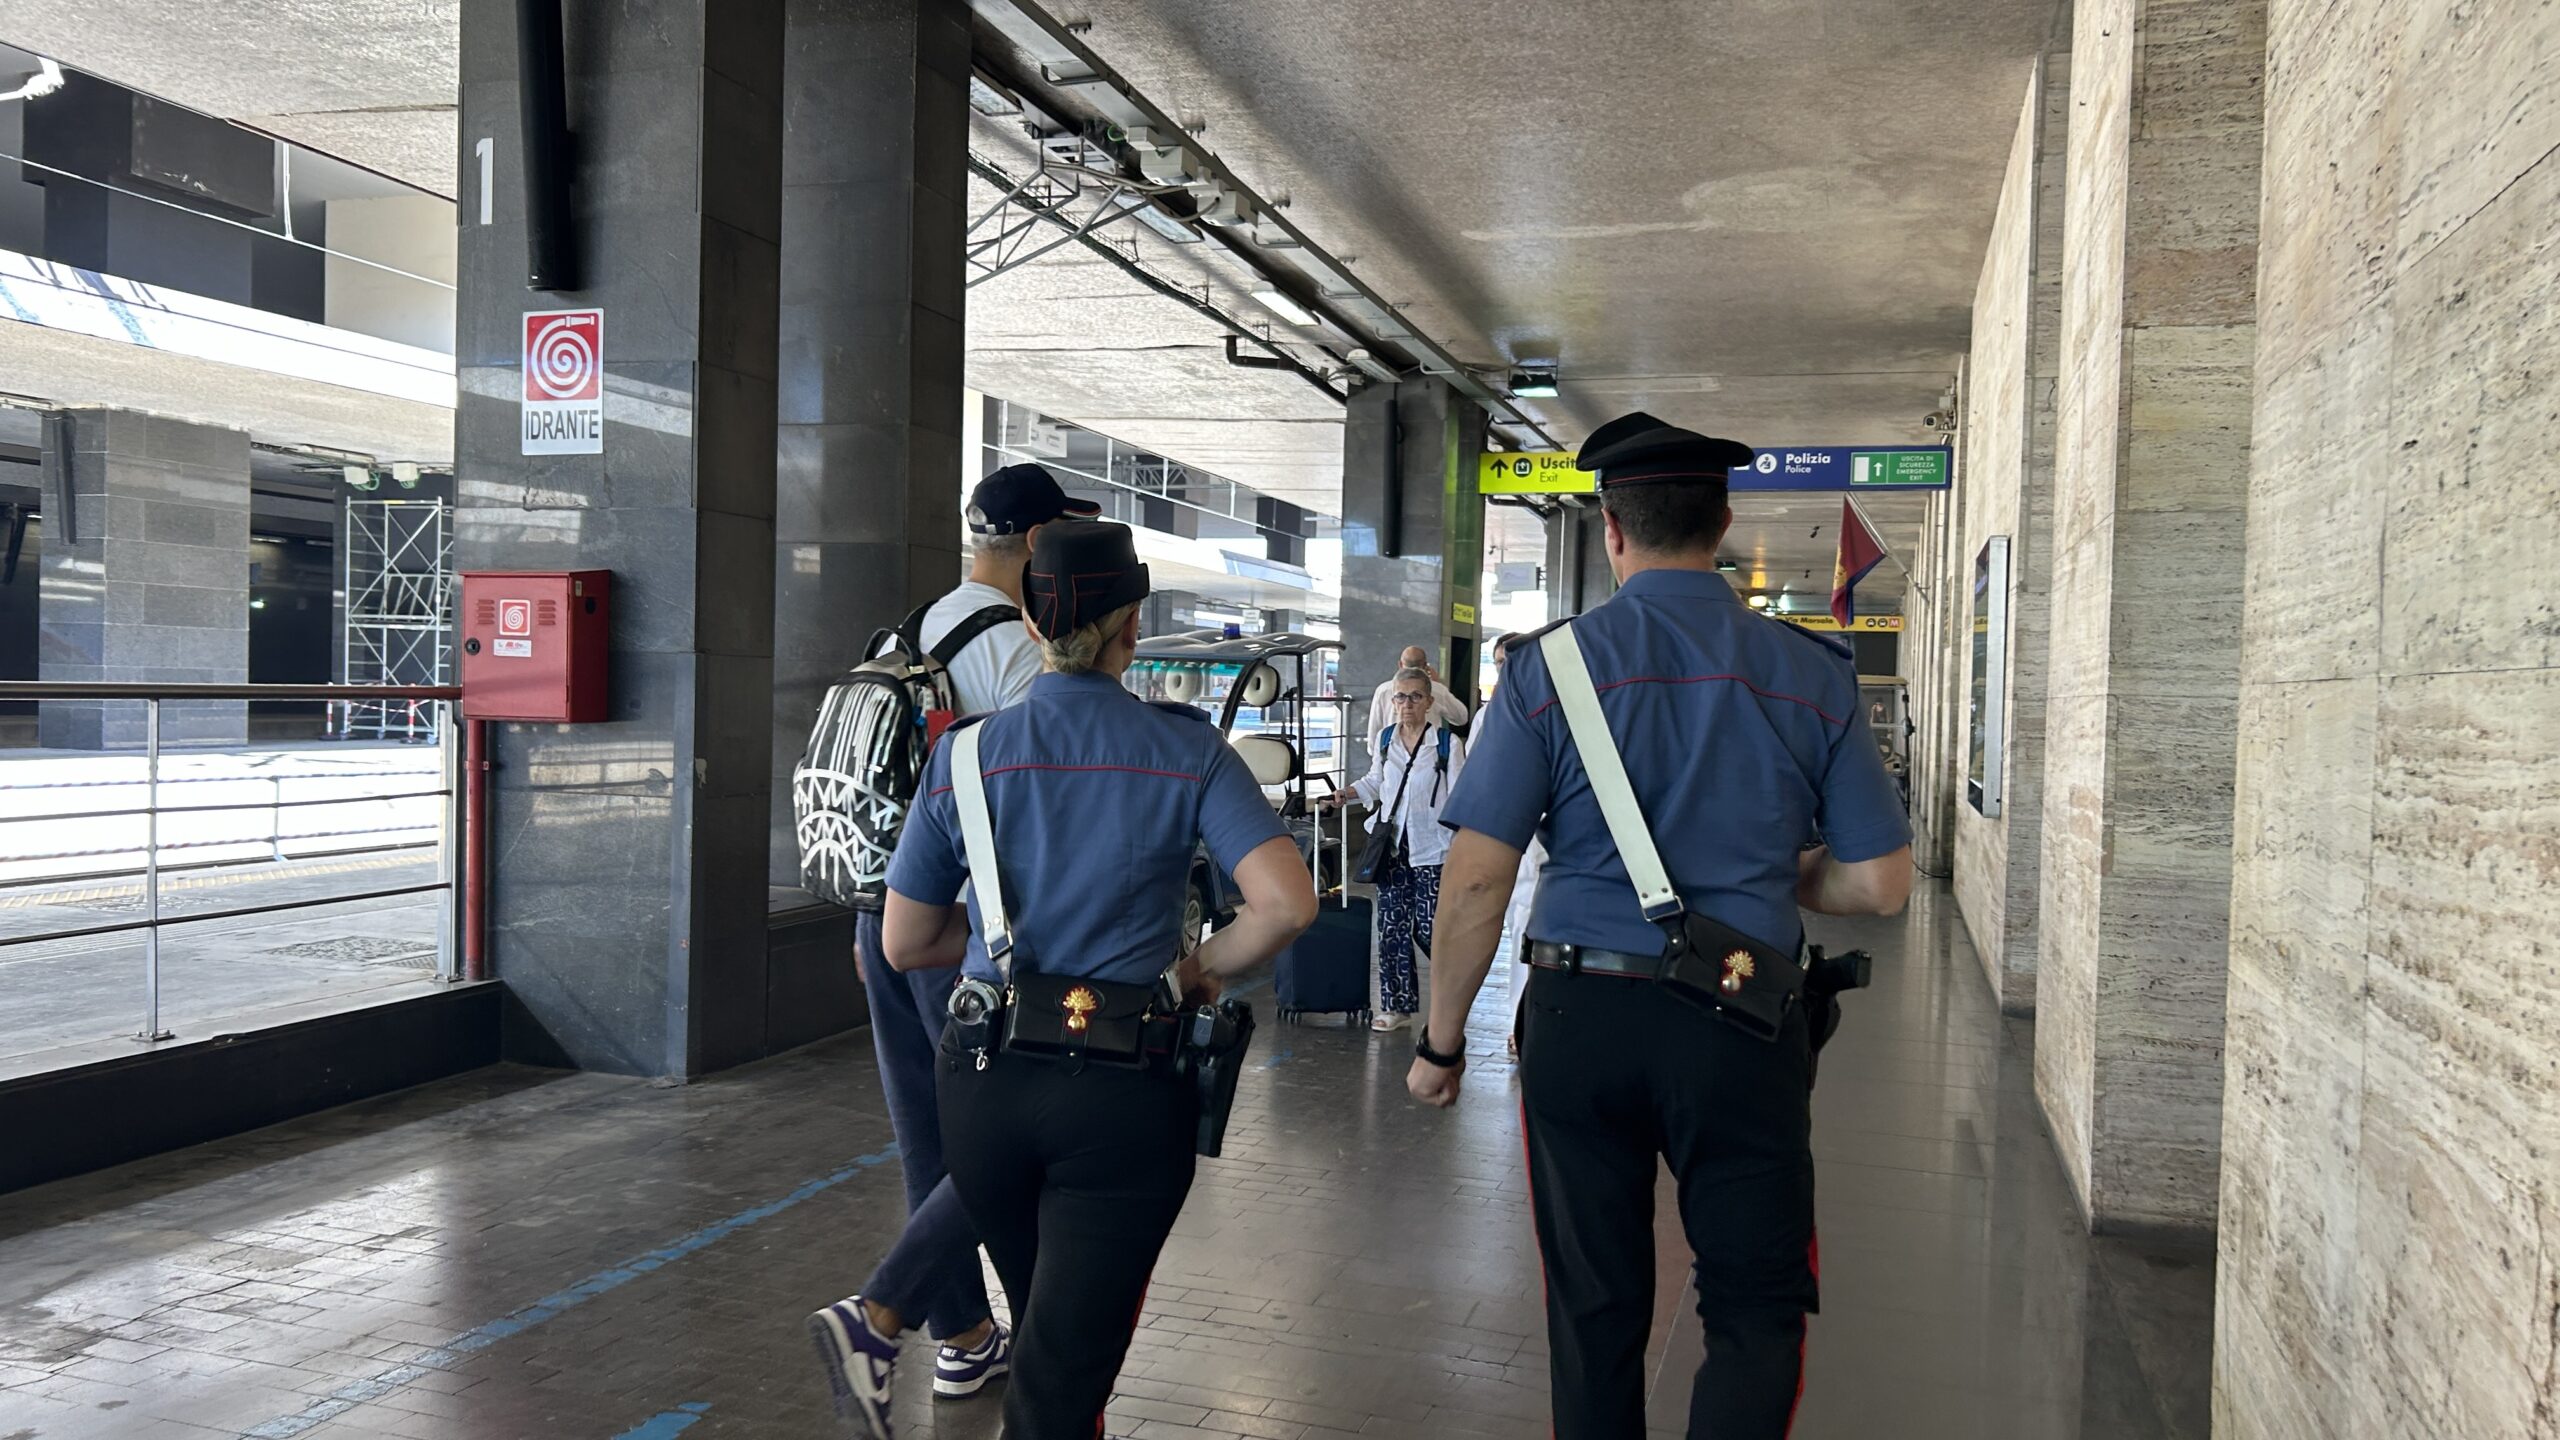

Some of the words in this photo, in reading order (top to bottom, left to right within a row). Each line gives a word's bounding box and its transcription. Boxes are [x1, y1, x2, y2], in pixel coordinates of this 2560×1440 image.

[476, 137, 494, 225] 1
[525, 409, 600, 440] IDRANTE
[1540, 457, 1577, 469] Uscit
[1785, 452, 1831, 464] Polizia
[1784, 464, 1812, 473] Police
[1540, 472, 1558, 482] Exit
[1131, 660, 1220, 669] POLIZIA
